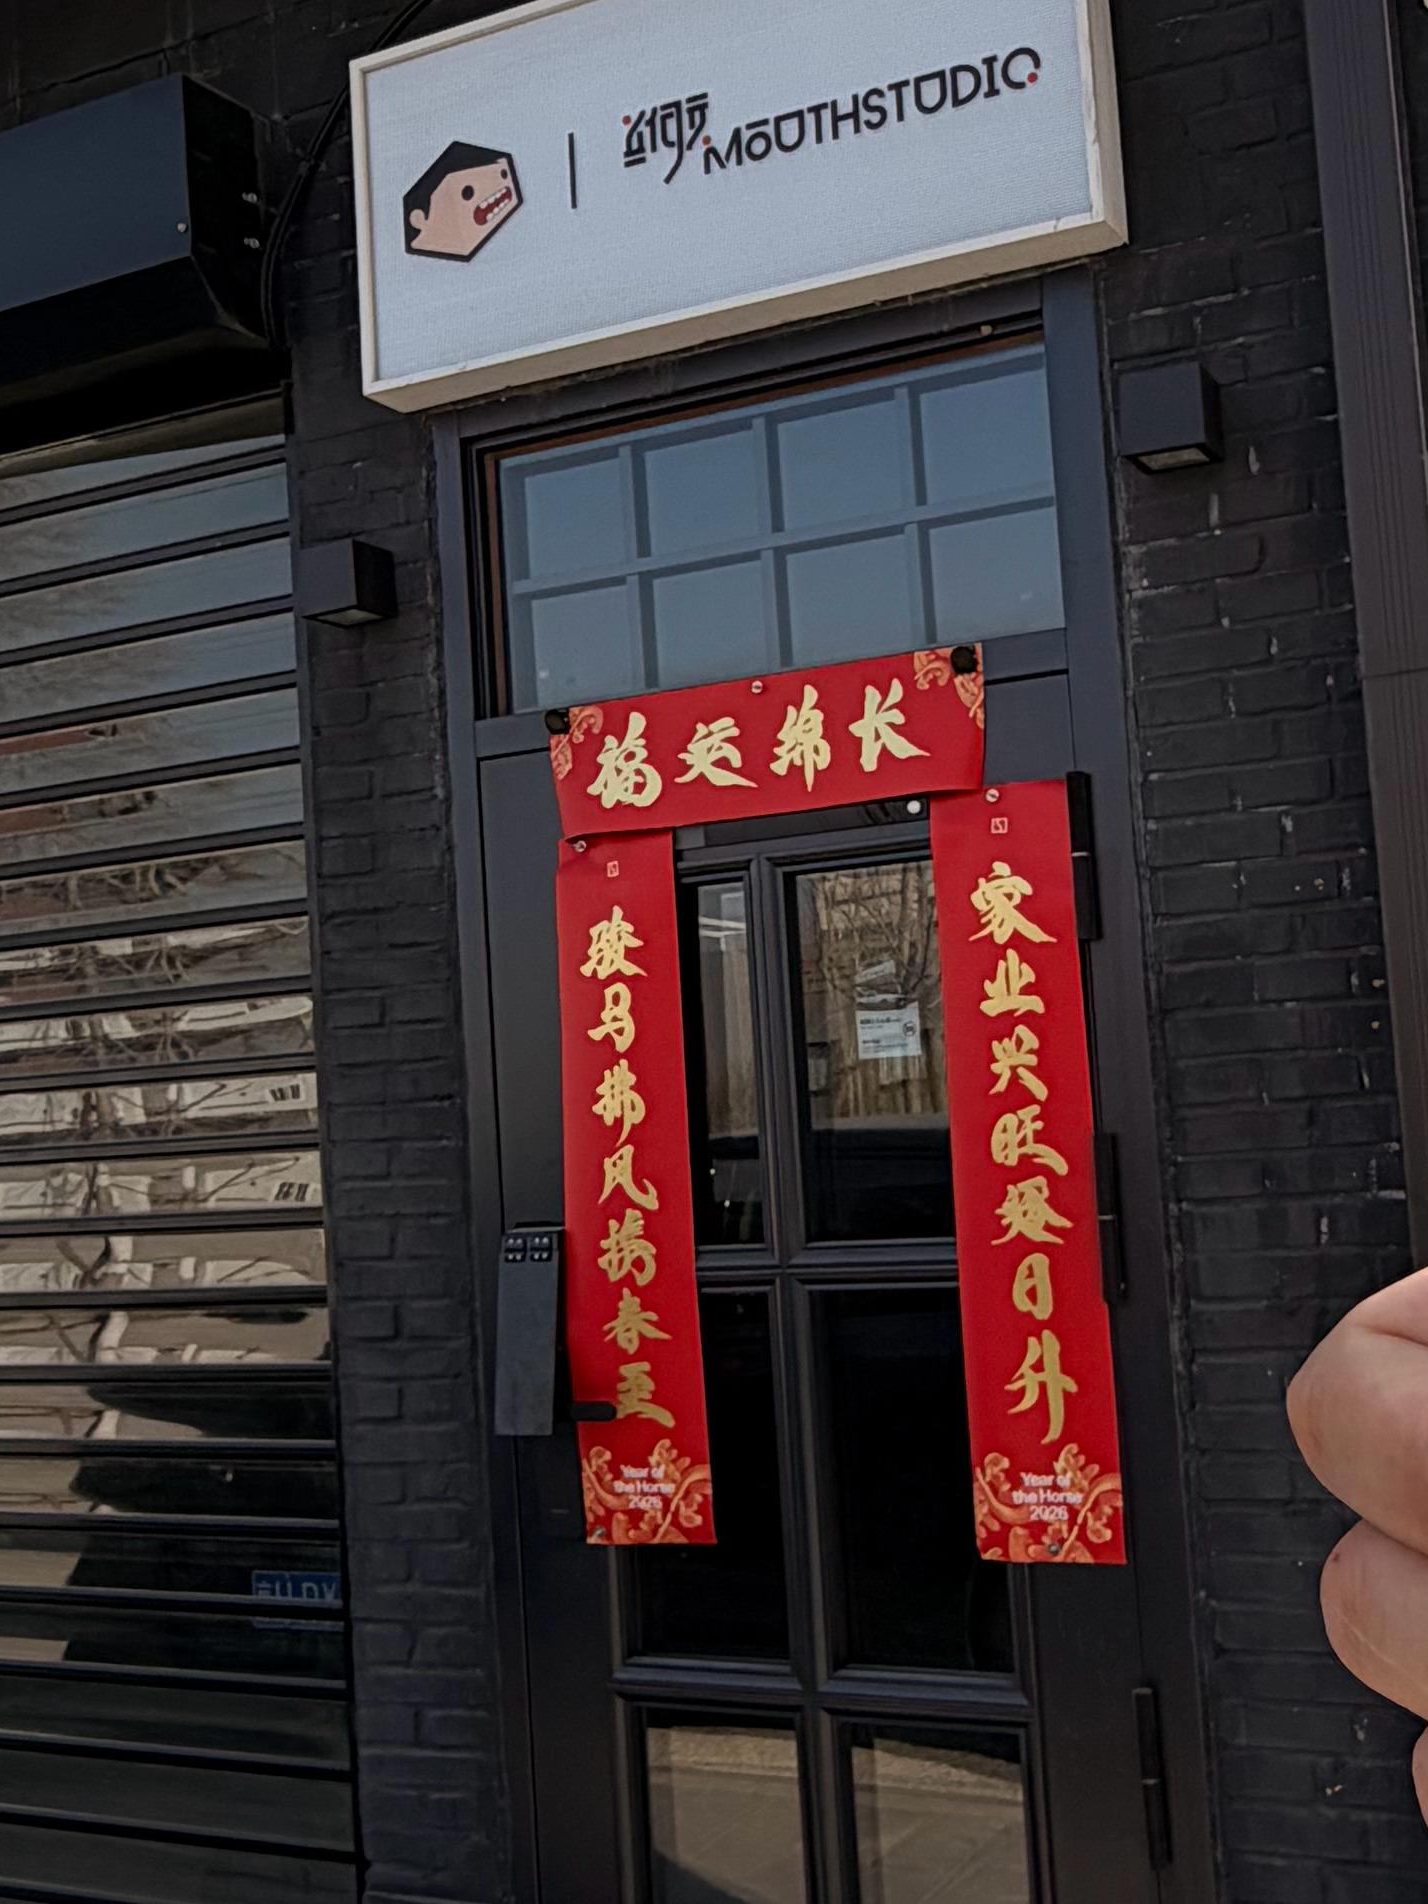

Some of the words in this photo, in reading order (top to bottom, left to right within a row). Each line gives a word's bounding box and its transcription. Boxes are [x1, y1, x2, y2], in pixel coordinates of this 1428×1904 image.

[586, 677, 931, 809] 福运绵长
[968, 860, 1079, 1445] 家业兴旺逐日升
[1020, 1471, 1055, 1487] Year
[1056, 1472, 1072, 1487] of
[1011, 1489, 1037, 1505] the
[1039, 1488, 1084, 1505] Horse
[1029, 1505, 1069, 1521] 2026
